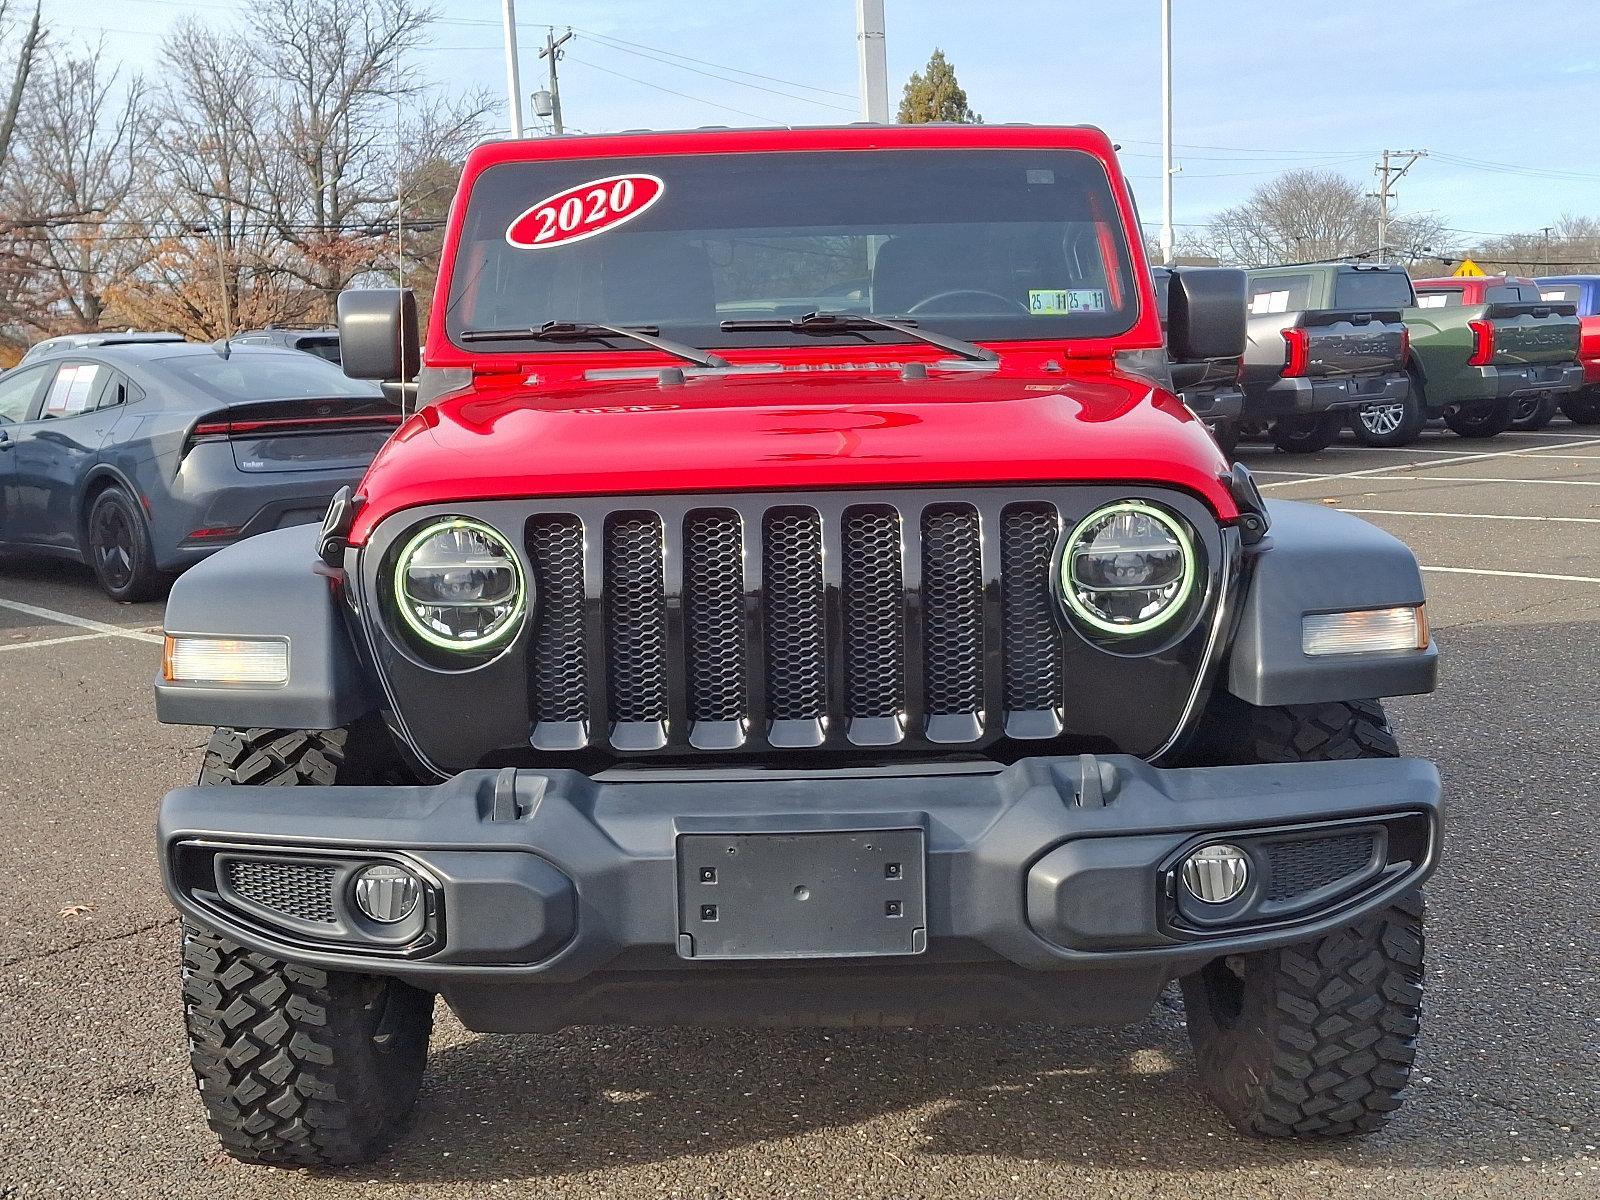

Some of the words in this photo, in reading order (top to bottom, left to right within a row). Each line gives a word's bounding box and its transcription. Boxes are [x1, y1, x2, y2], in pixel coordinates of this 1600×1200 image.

[533, 179, 634, 243] 2020
[1031, 293, 1042, 310] 25
[1056, 293, 1067, 310] 11
[1068, 292, 1079, 309] 25
[1092, 292, 1104, 308] 11
